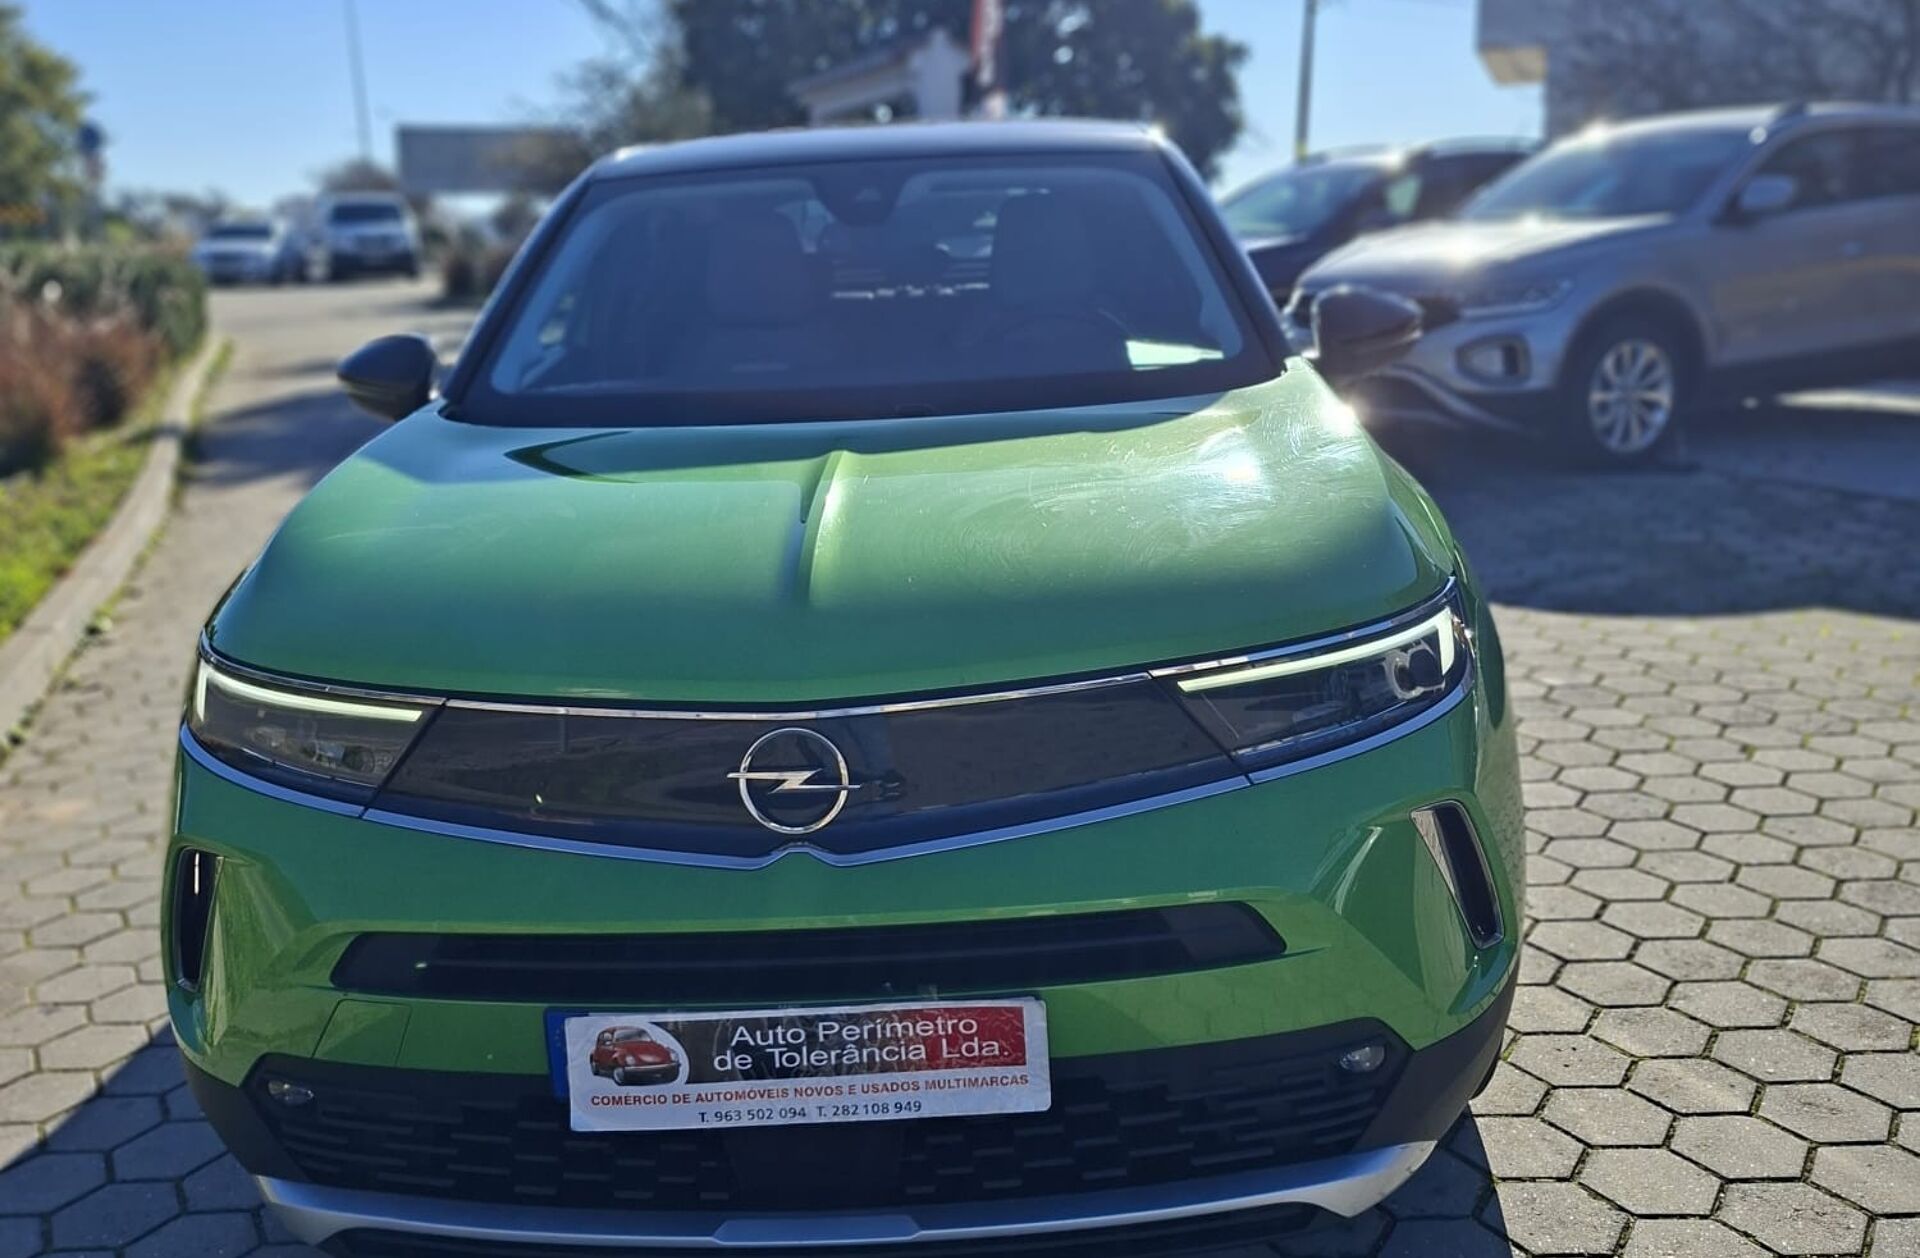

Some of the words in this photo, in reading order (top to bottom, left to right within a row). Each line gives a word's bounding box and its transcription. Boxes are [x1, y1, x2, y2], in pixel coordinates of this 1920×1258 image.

[731, 1025, 805, 1047] Auto
[818, 1017, 978, 1043] Perímetro
[713, 1050, 753, 1071] de
[767, 1042, 926, 1069] Tolerância
[942, 1037, 1009, 1058] Lda.
[591, 1091, 668, 1106] COMÉRCIO
[672, 1093, 690, 1105] DE
[695, 1087, 789, 1103] AUTOMÓVEIS
[794, 1085, 843, 1097] NOVOS
[848, 1084, 856, 1095] E
[861, 1081, 920, 1094] USADOS
[925, 1074, 1029, 1090] MULTIMARCAS
[698, 1112, 709, 1123] T.
[714, 1109, 741, 1121] 963
[747, 1108, 774, 1120] 502
[779, 1107, 806, 1119] 094
[817, 1106, 827, 1117] T.
[831, 1104, 859, 1117] 282
[863, 1102, 889, 1114] 108
[894, 1100, 922, 1113] 949
